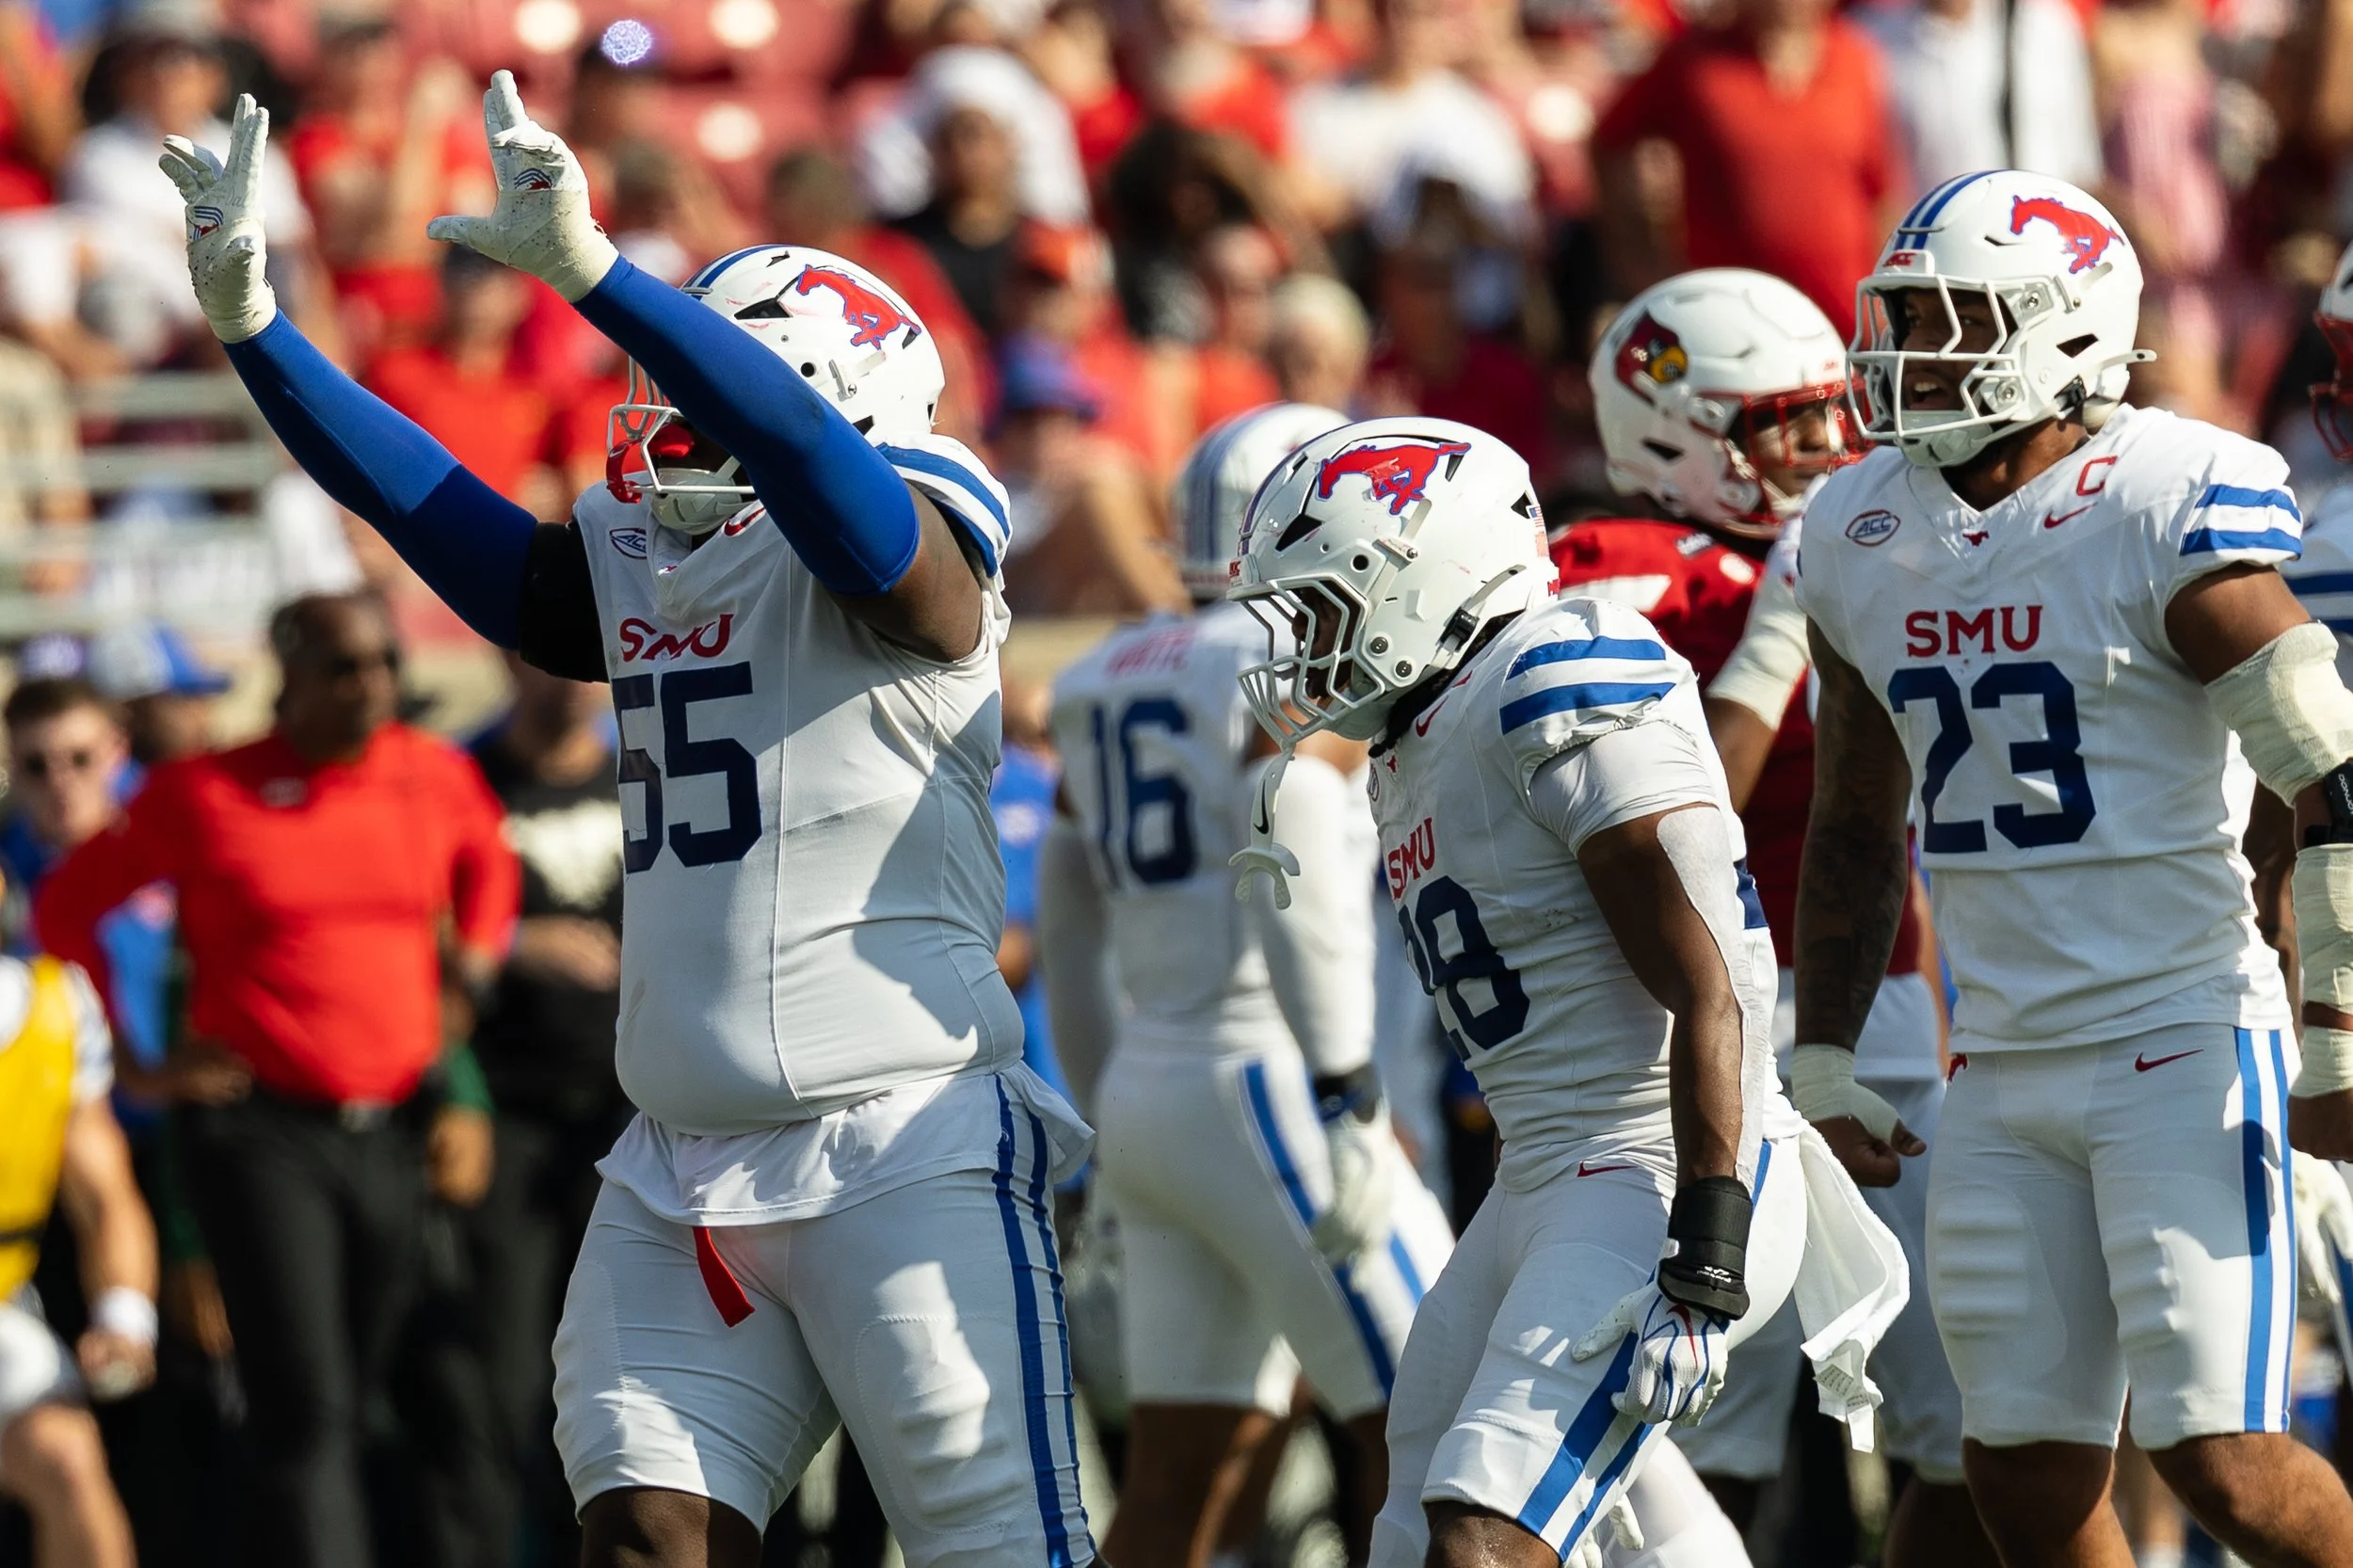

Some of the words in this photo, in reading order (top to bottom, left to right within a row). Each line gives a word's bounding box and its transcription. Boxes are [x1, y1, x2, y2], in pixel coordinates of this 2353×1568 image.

[2075, 456, 2118, 496] C
[1854, 515, 1892, 537] ACC
[619, 614, 734, 662] SMU
[1905, 605, 2043, 657] SMU
[612, 662, 762, 874] 55
[1886, 661, 2097, 854] 23
[1087, 696, 1198, 891] 16
[1387, 816, 1435, 901] SMU
